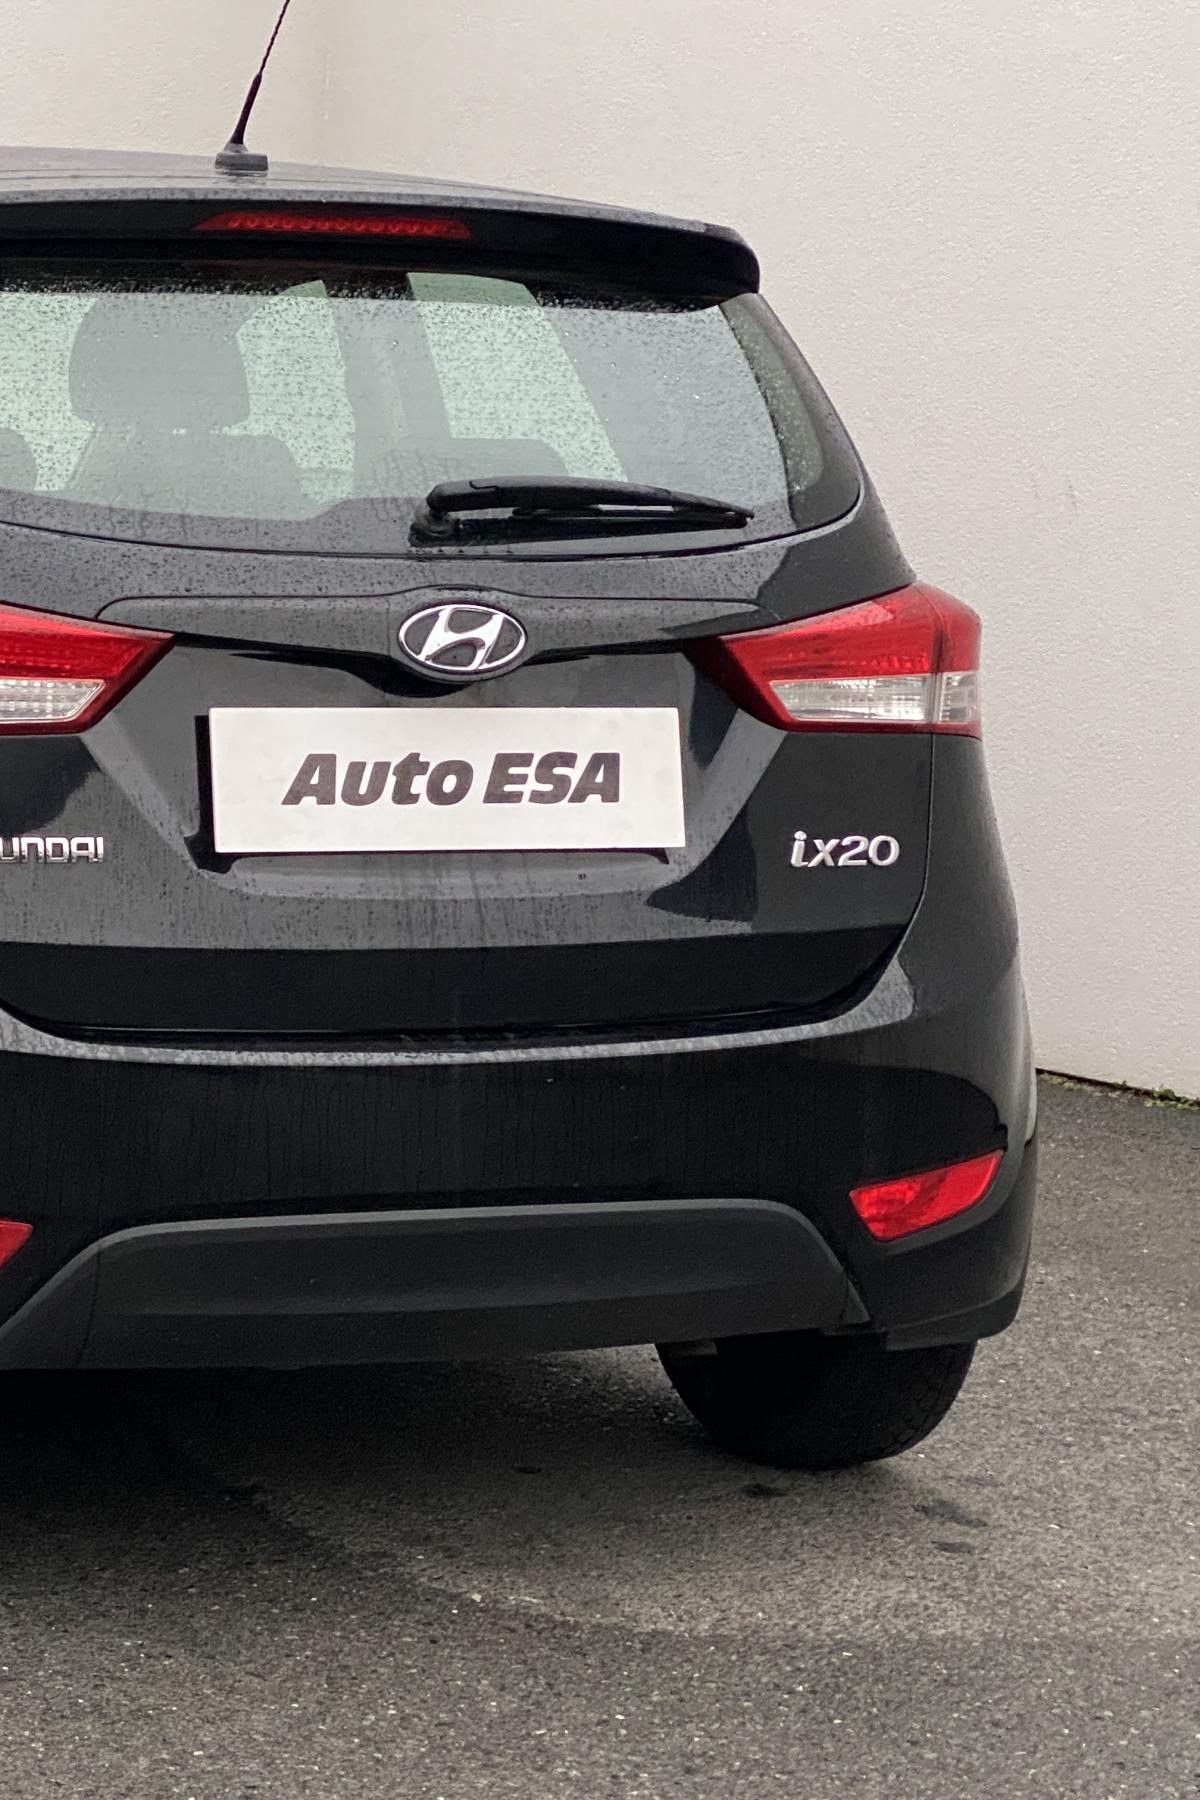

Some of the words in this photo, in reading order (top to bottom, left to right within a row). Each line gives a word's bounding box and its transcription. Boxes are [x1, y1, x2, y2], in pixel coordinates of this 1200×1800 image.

[281, 752, 474, 806] Auto
[482, 752, 621, 804] ESA
[790, 830, 900, 868] ix20
